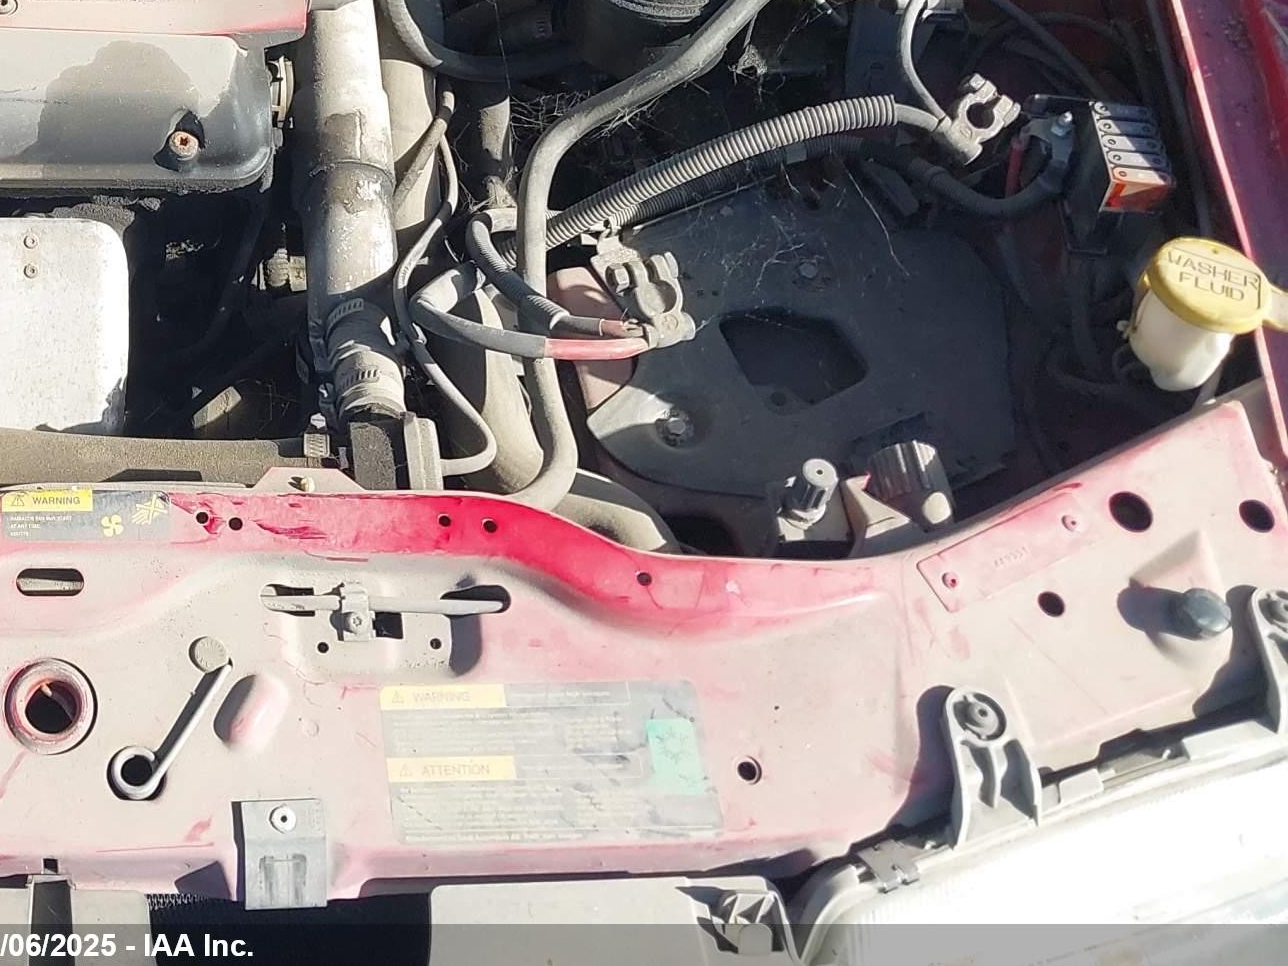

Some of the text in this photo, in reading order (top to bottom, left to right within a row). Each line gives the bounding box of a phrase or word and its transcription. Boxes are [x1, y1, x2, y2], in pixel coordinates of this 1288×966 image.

[1167, 249, 1259, 291] WASHER
[1178, 271, 1245, 302] FLUID
[32, 496, 81, 506] WARNING
[413, 691, 471, 703] WARNING
[421, 764, 490, 776] ATTENTION
